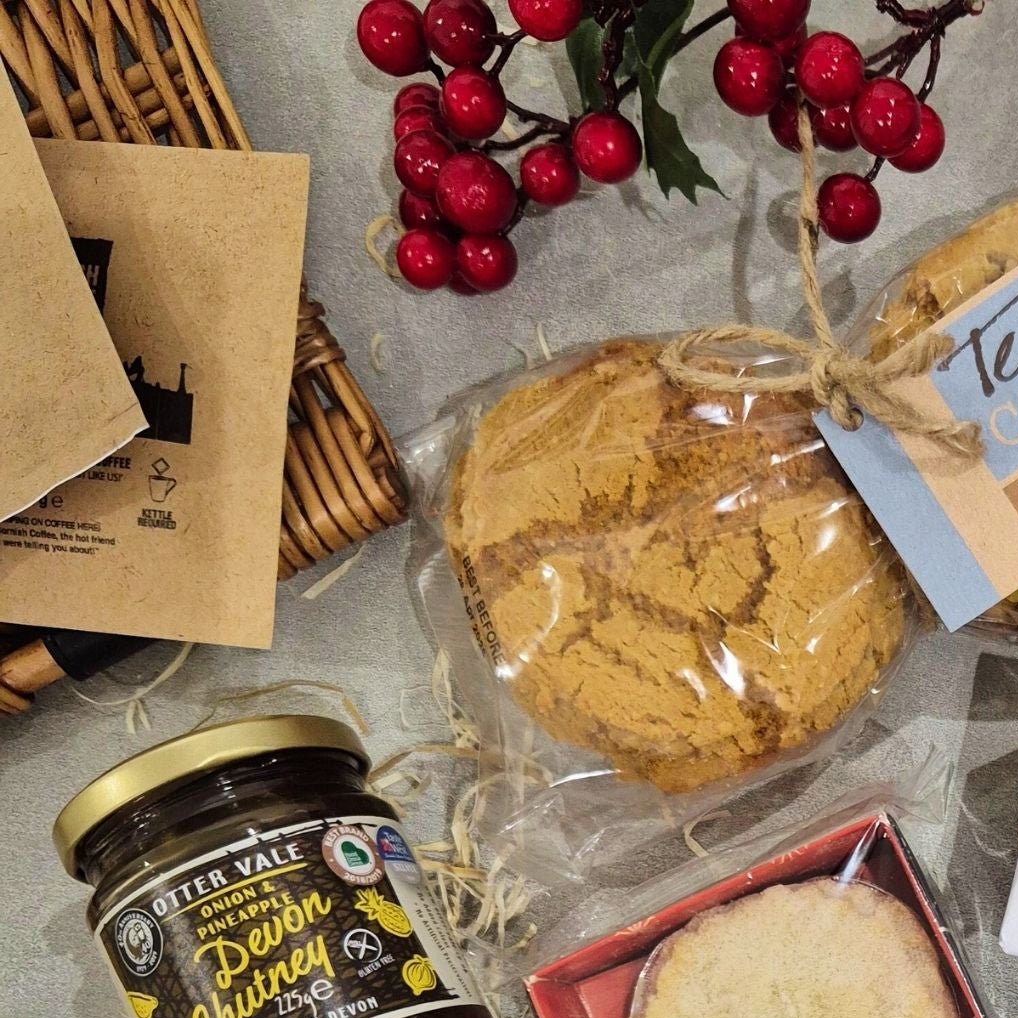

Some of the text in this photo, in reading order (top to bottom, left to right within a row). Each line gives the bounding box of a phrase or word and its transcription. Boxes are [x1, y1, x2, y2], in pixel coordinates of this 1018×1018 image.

[45, 520, 76, 530] COFFEE
[137, 517, 177, 529] REQUIRED
[142, 509, 173, 520] KETTLE
[0, 528, 28, 538] ornish
[60, 533, 74, 542] the
[75, 534, 90, 543] hot
[91, 536, 116, 546] friend
[51, 545, 68, 553] you
[463, 555, 506, 665] BEST BEFORE
[152, 842, 305, 917] OTTER VALE
[200, 880, 276, 919] ONION &
[197, 891, 295, 940] PINEAPPLE
[193, 891, 332, 989] Devon
